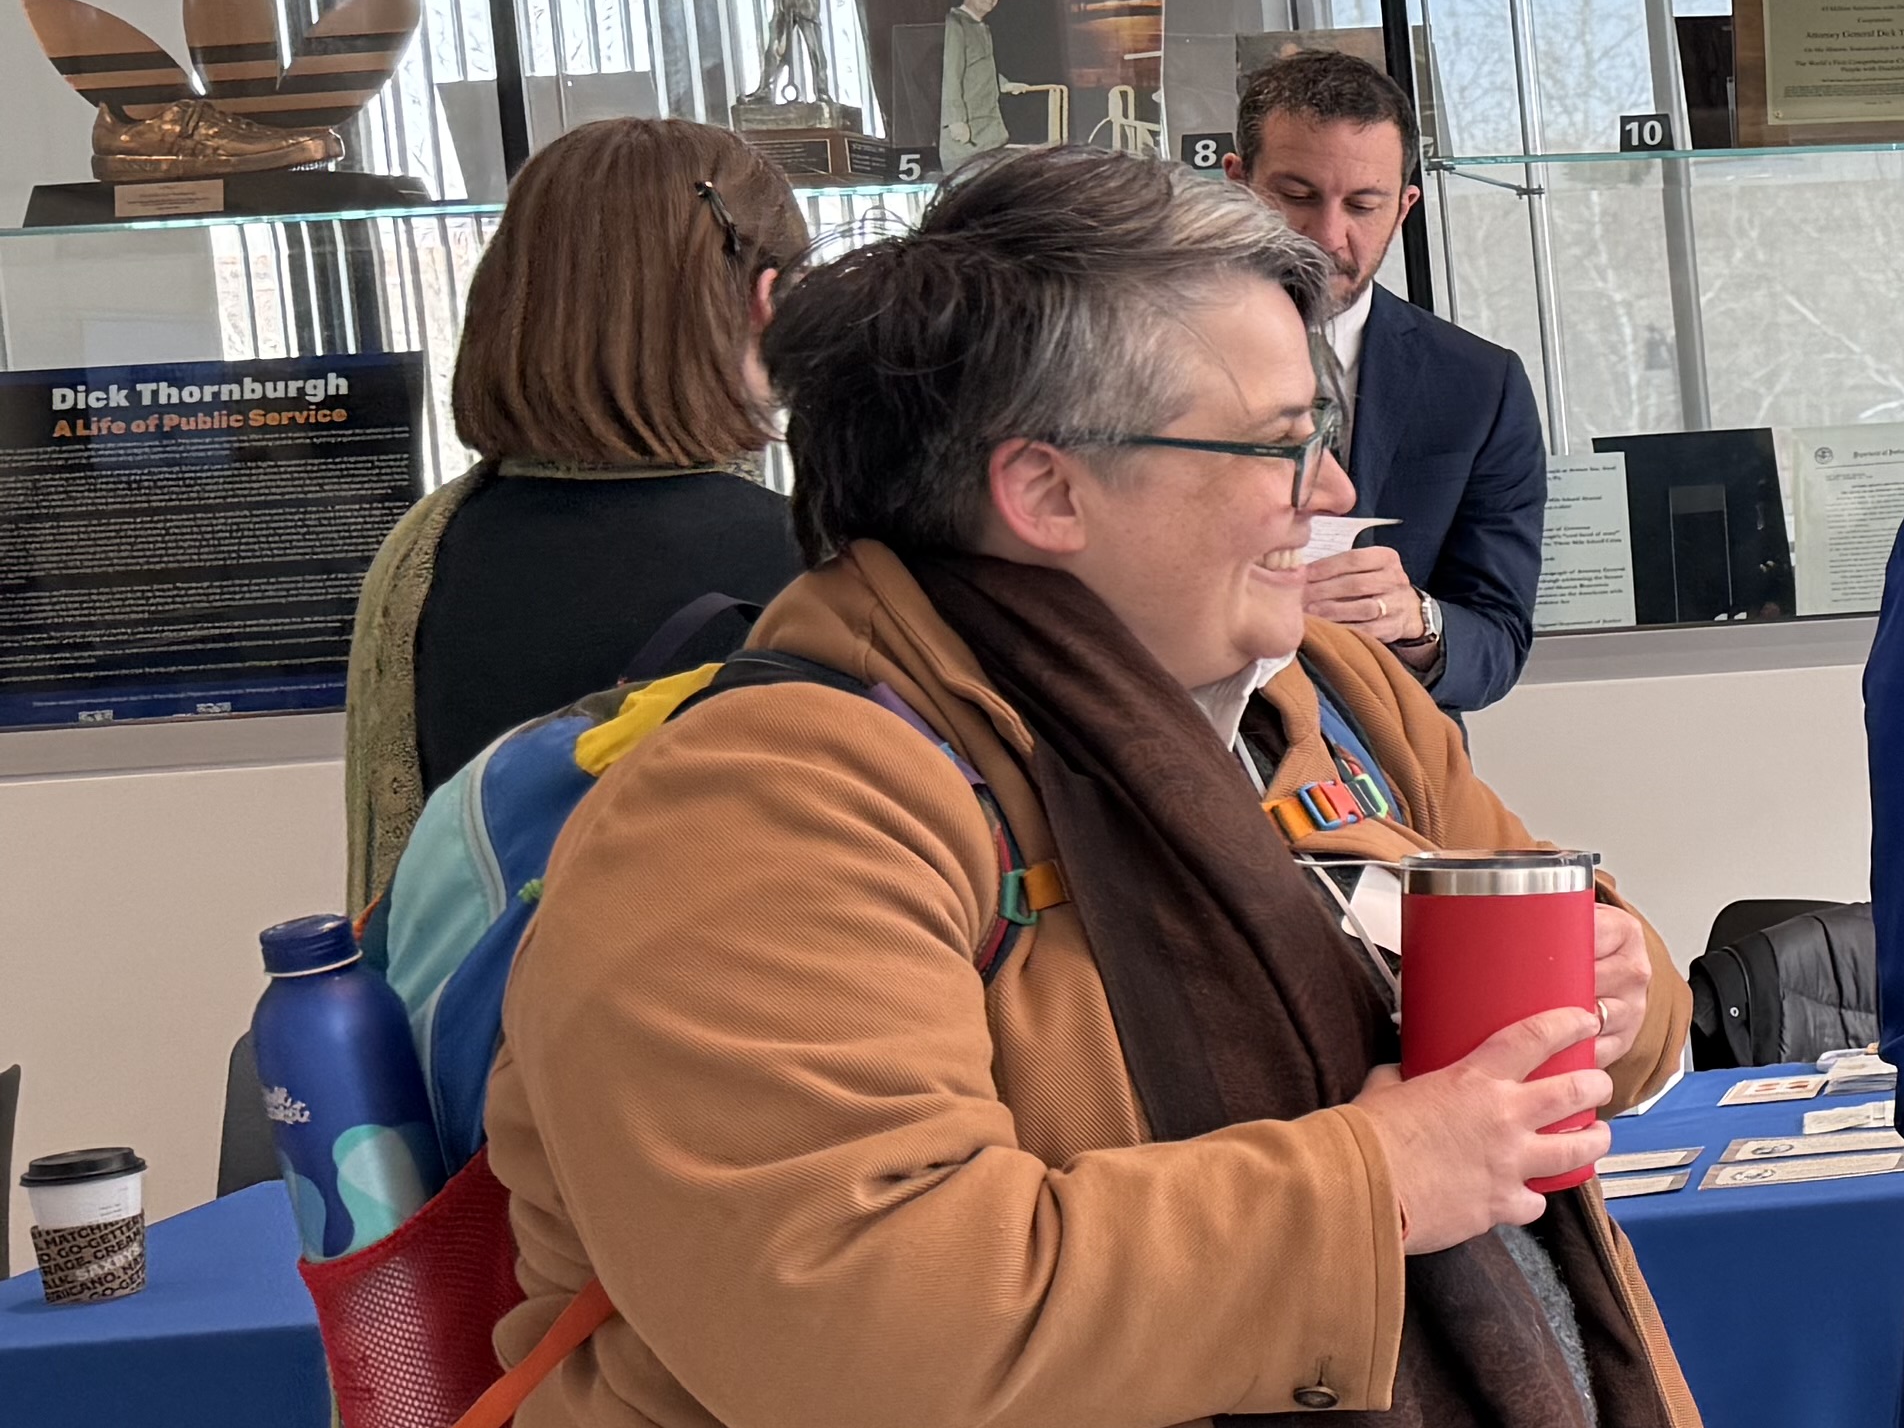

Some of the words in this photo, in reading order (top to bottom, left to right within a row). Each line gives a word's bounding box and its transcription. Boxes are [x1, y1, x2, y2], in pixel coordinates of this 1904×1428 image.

[1625, 120, 1663, 146] 10
[898, 153, 922, 182] 5
[1194, 139, 1217, 167] 8
[52, 384, 130, 411] Dick
[136, 372, 350, 405] Thornburgh
[52, 419, 72, 438] A
[75, 415, 125, 436] Life
[130, 413, 159, 434] of
[163, 409, 243, 431] Public
[248, 405, 348, 428] Service
